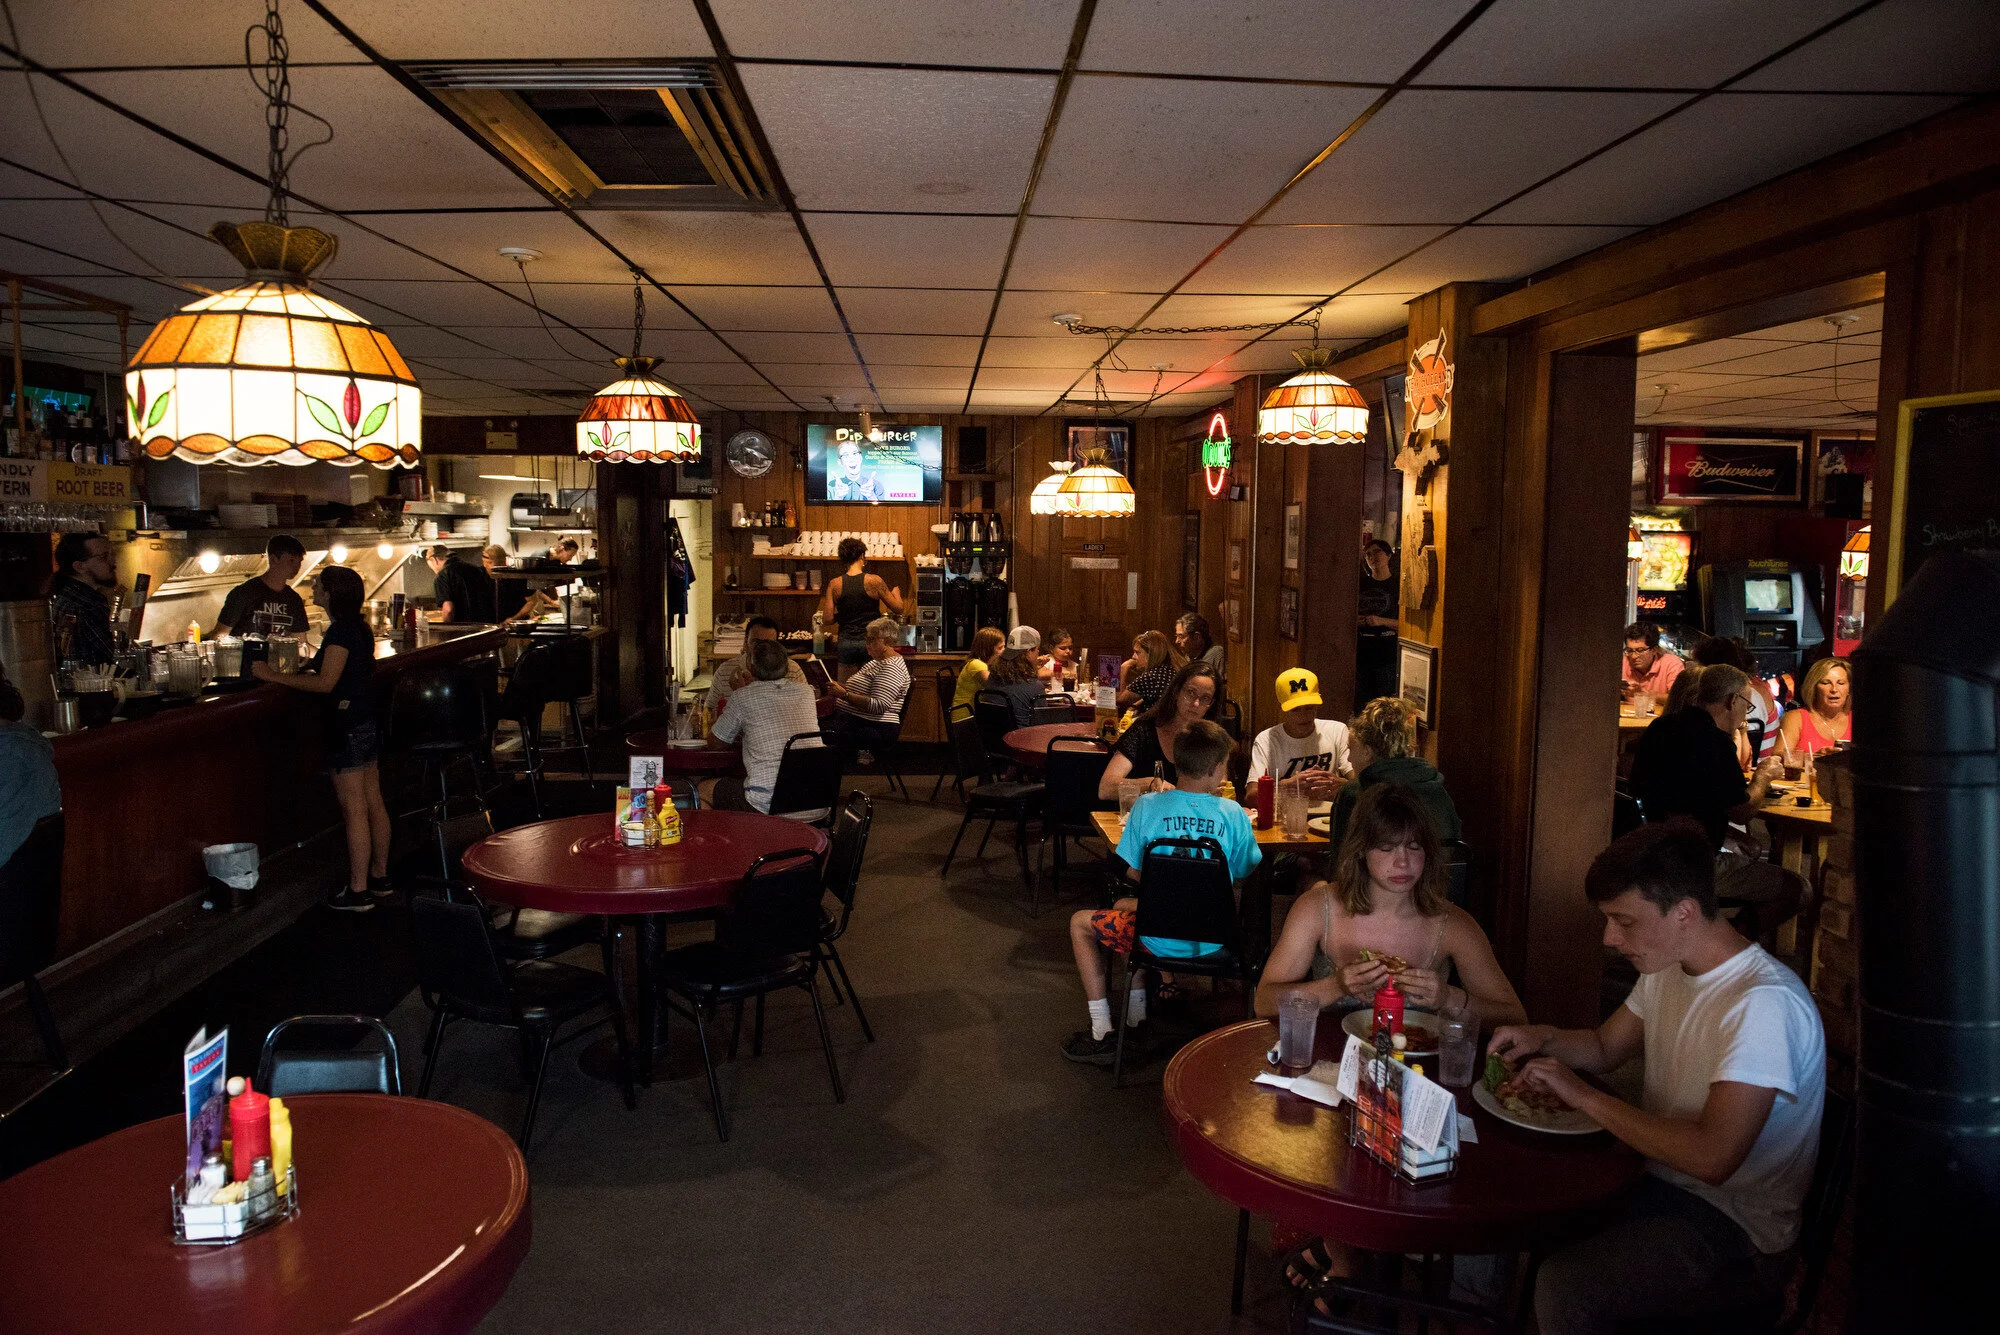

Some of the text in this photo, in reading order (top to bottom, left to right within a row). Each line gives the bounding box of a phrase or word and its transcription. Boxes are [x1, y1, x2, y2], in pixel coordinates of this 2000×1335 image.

[835, 428, 864, 445] Dip
[74, 465, 102, 477] DRAFT
[1685, 460, 1776, 478] Budweiser
[0, 481, 31, 496] ERN
[56, 480, 125, 497] ROOT BEER
[263, 602, 288, 615] NIKE
[1289, 679, 1309, 694] M
[1163, 816, 1216, 834] TUPPER
